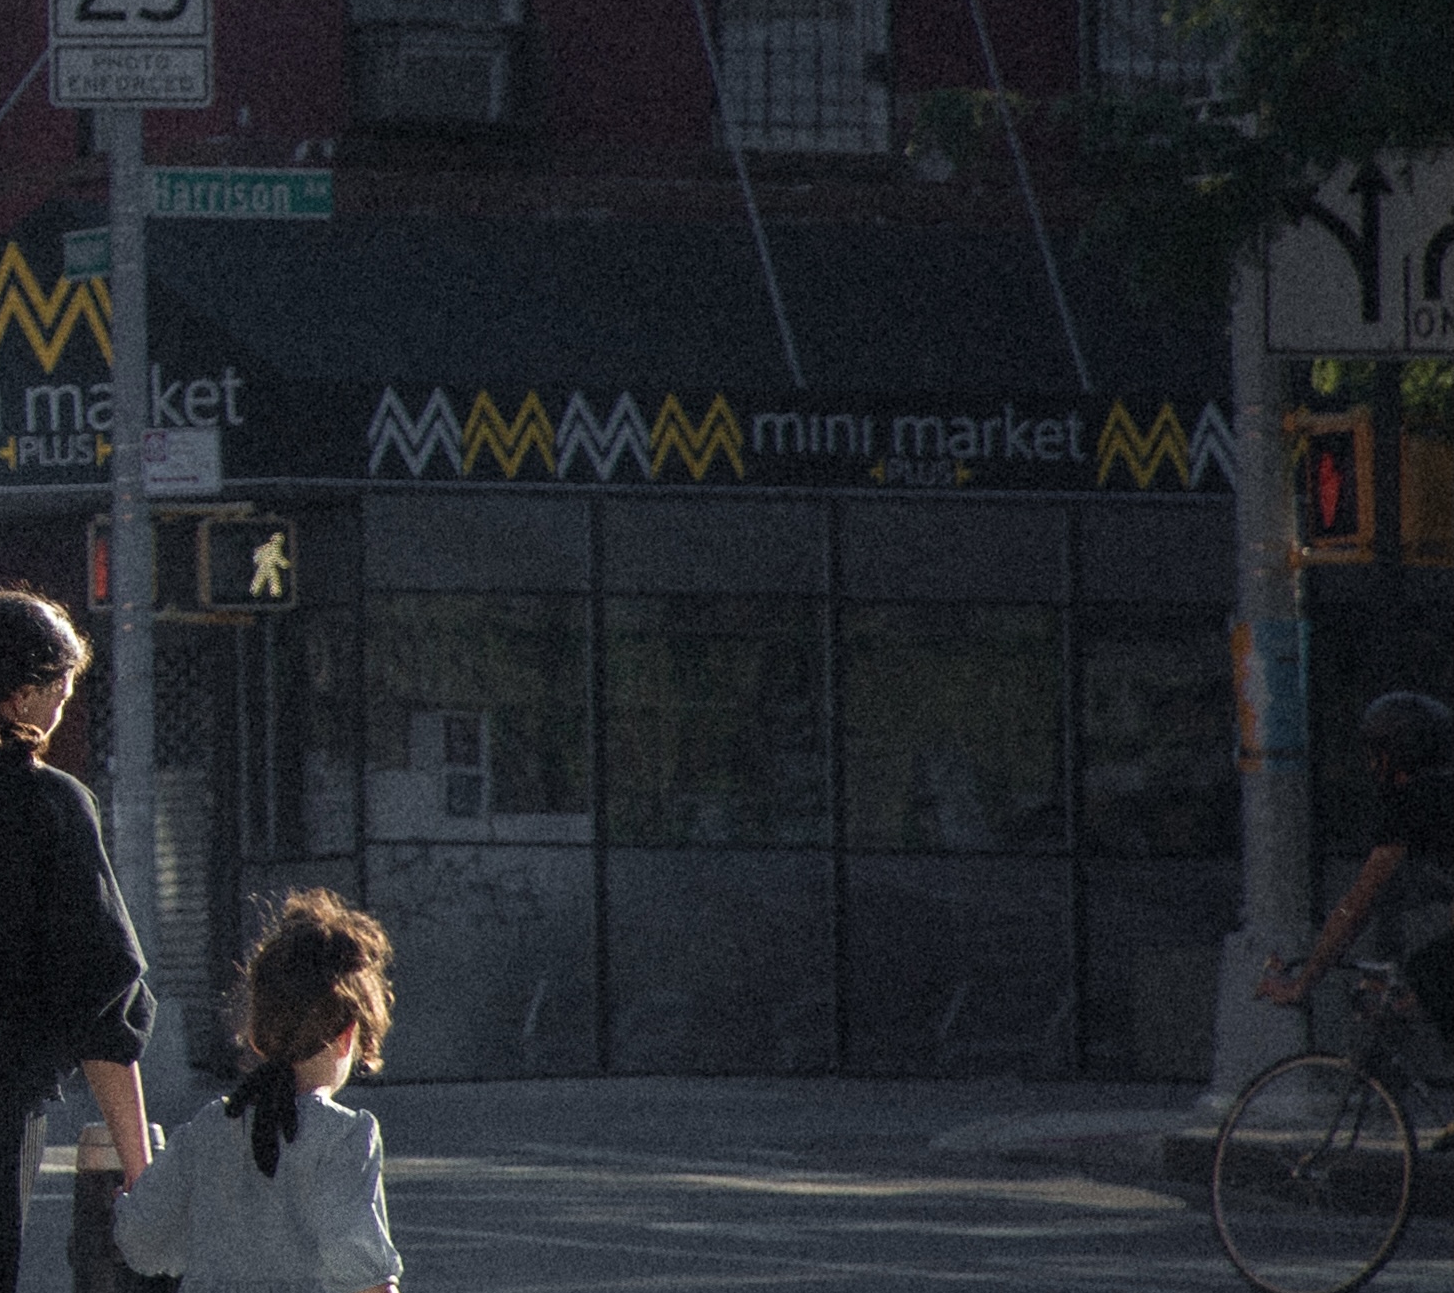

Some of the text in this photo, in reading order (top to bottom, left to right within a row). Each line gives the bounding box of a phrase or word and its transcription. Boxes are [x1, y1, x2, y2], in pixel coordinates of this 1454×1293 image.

[91, 53, 171, 70] PHOTO
[152, 175, 290, 212] Harrison
[25, 363, 246, 434] maket
[18, 434, 95, 466] PLUS
[751, 411, 874, 454] mini
[894, 403, 1087, 461] market
